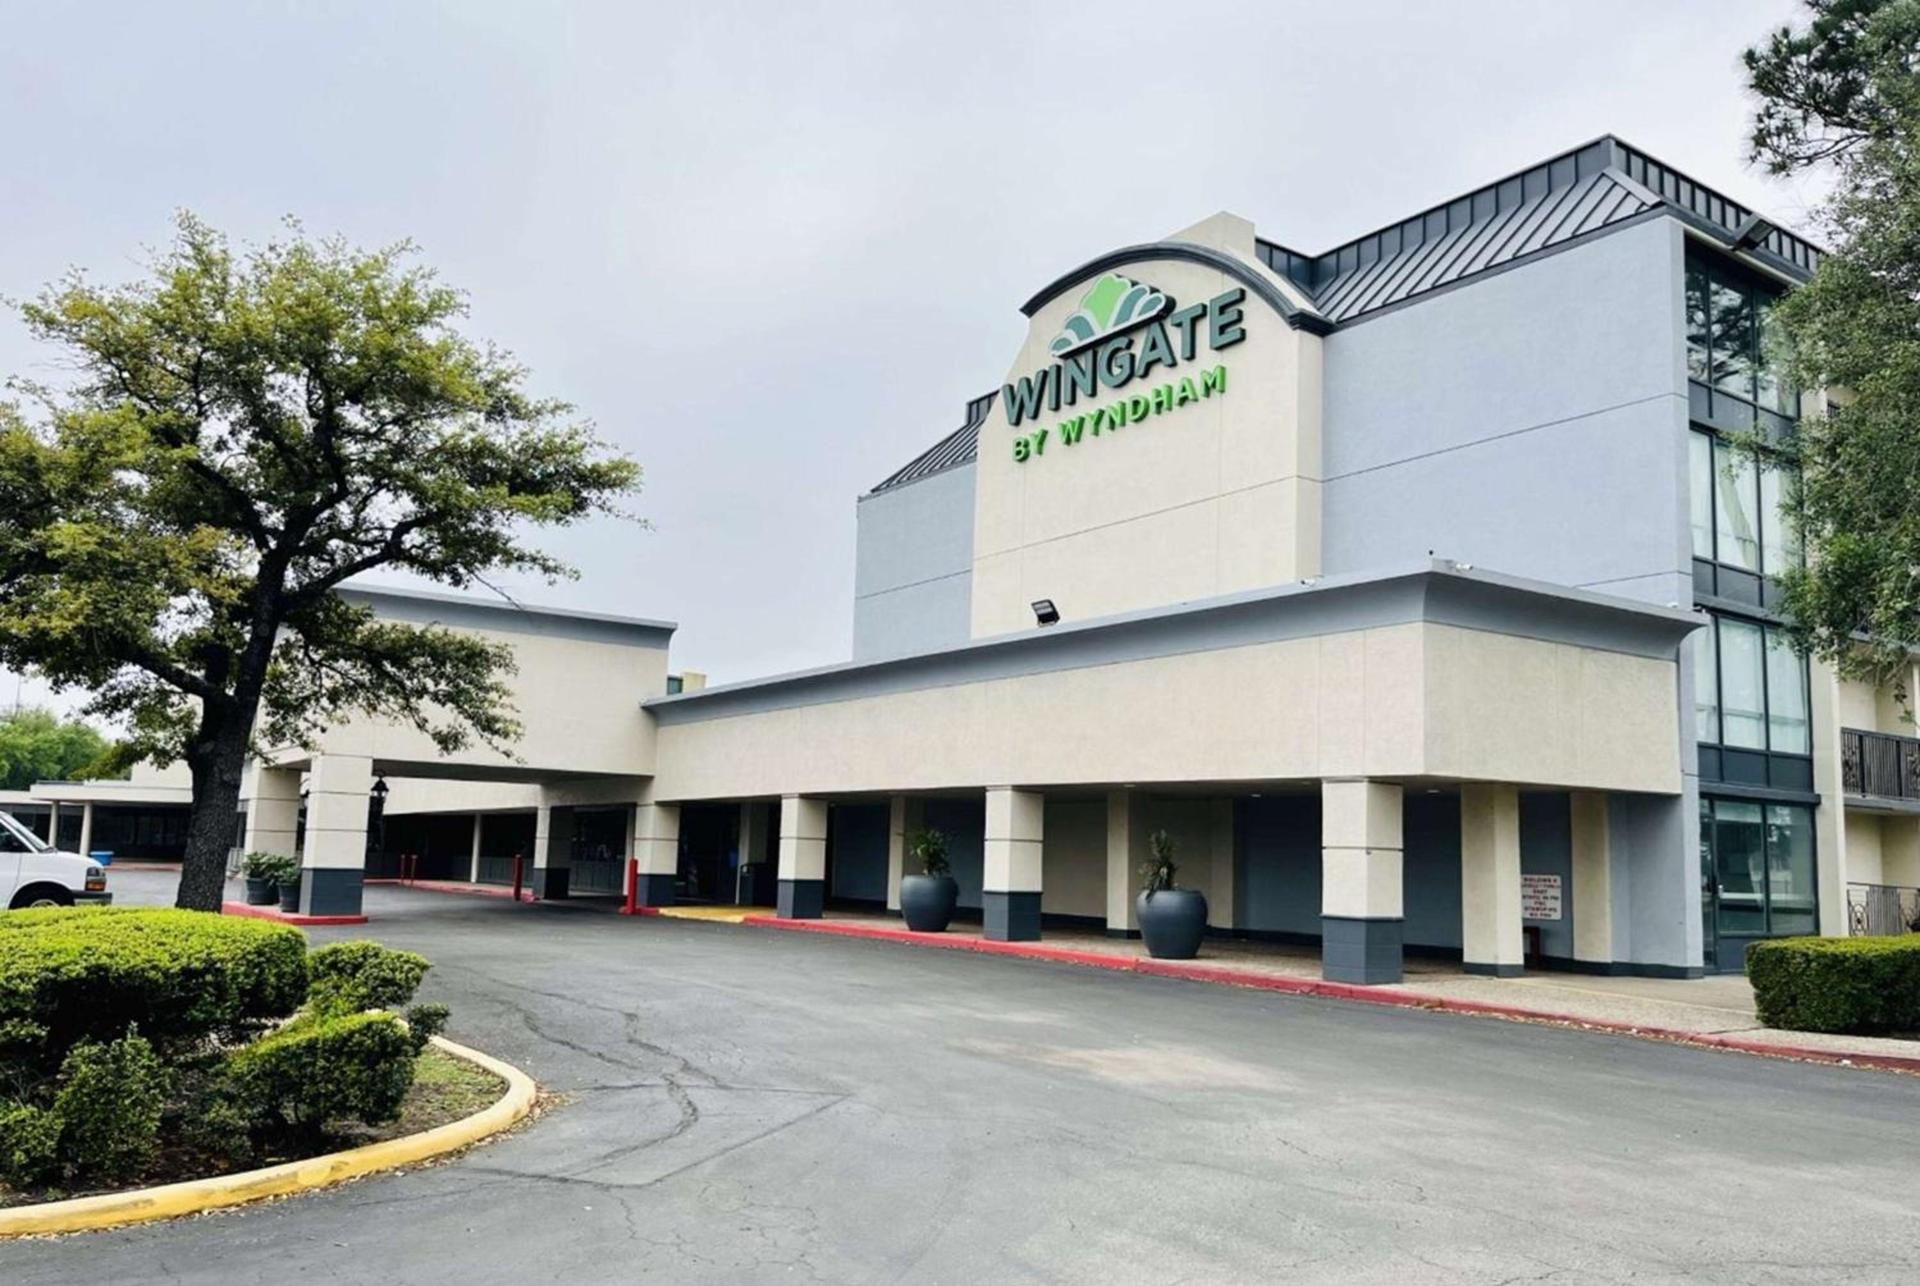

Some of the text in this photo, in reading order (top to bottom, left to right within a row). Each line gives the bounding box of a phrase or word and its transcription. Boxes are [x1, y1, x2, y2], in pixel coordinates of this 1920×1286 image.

[1002, 288, 1246, 427] WINGATE
[1012, 365, 1226, 462] BY WYNDHAM
